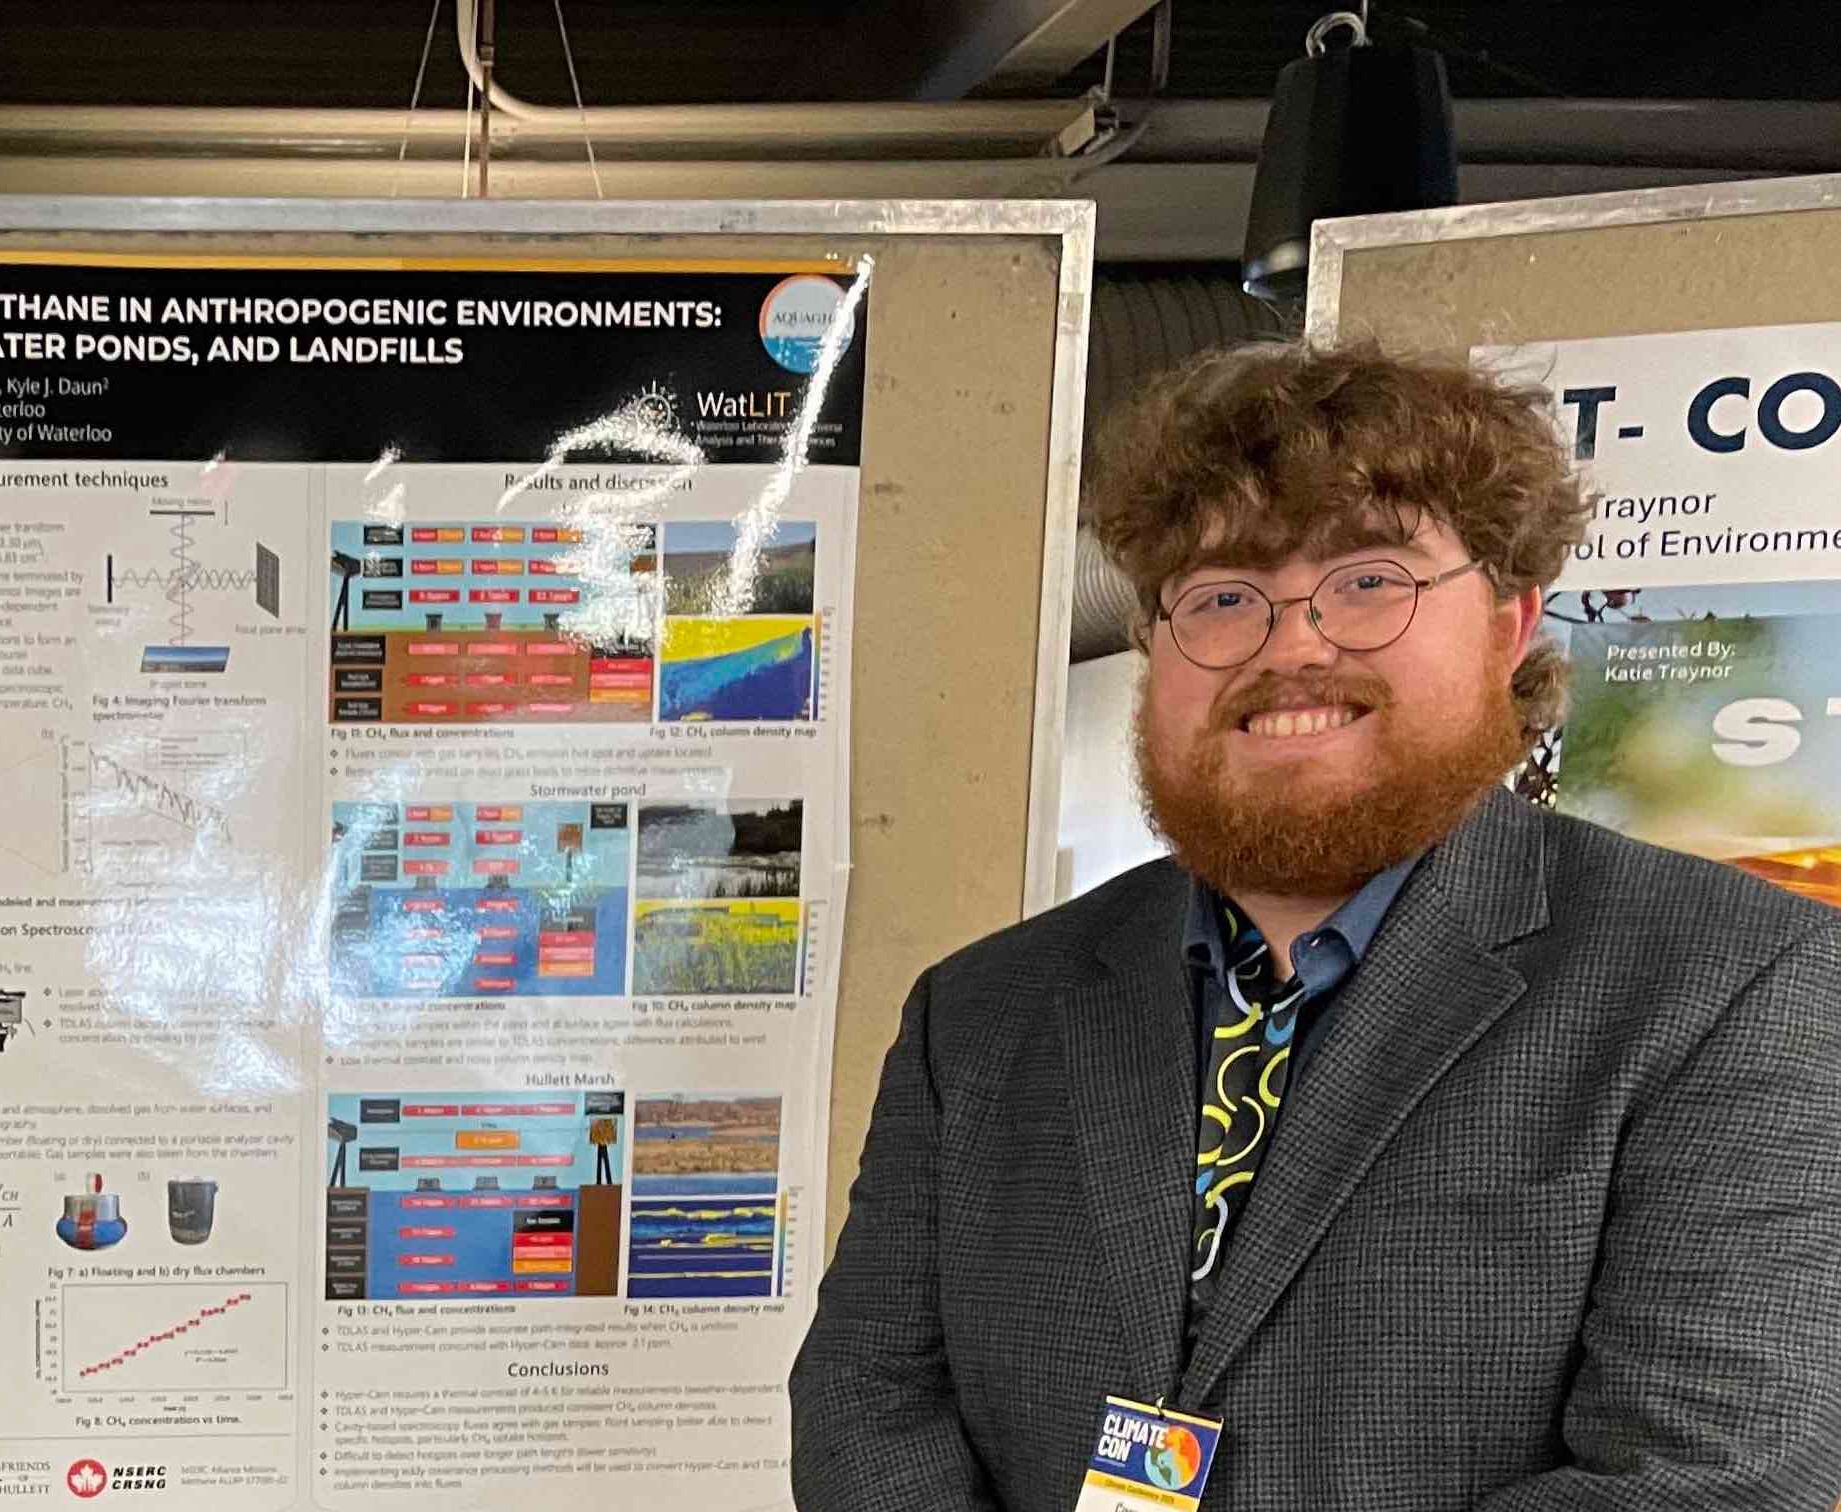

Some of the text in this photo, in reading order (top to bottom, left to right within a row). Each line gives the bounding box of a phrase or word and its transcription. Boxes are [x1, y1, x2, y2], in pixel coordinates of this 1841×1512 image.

[118, 297, 153, 323] IN
[160, 297, 448, 326] ANTHROPOGENIC
[455, 299, 723, 328] ENVIRONMENTS:
[75, 334, 199, 366] PONDS,
[207, 336, 280, 362] AND
[289, 336, 464, 364] LANDFILLS
[7, 379, 41, 398] Kyle
[697, 391, 792, 418] WatLIT
[15, 424, 35, 440] of
[36, 424, 113, 441] Waterloo
[74, 471, 170, 491] techniques
[568, 474, 601, 490] and
[1564, 534, 1605, 561] ol
[1616, 532, 1650, 559] of
[1606, 645, 1704, 662] Presented
[1604, 662, 1734, 683] Katie Traynor
[530, 784, 647, 801] Stormwater pond
[525, 1073, 616, 1086] Hullett Marsh
[47, 1268, 65, 1279] Fig
[507, 1361, 610, 1378] Conclusions
[1102, 1413, 1169, 1450] CLIMATE
[1097, 1435, 1132, 1463] CON
[0, 1460, 52, 1473] FRIENDS
[111, 1466, 168, 1477] NSERC
[110, 1479, 167, 1489] CRSNG
